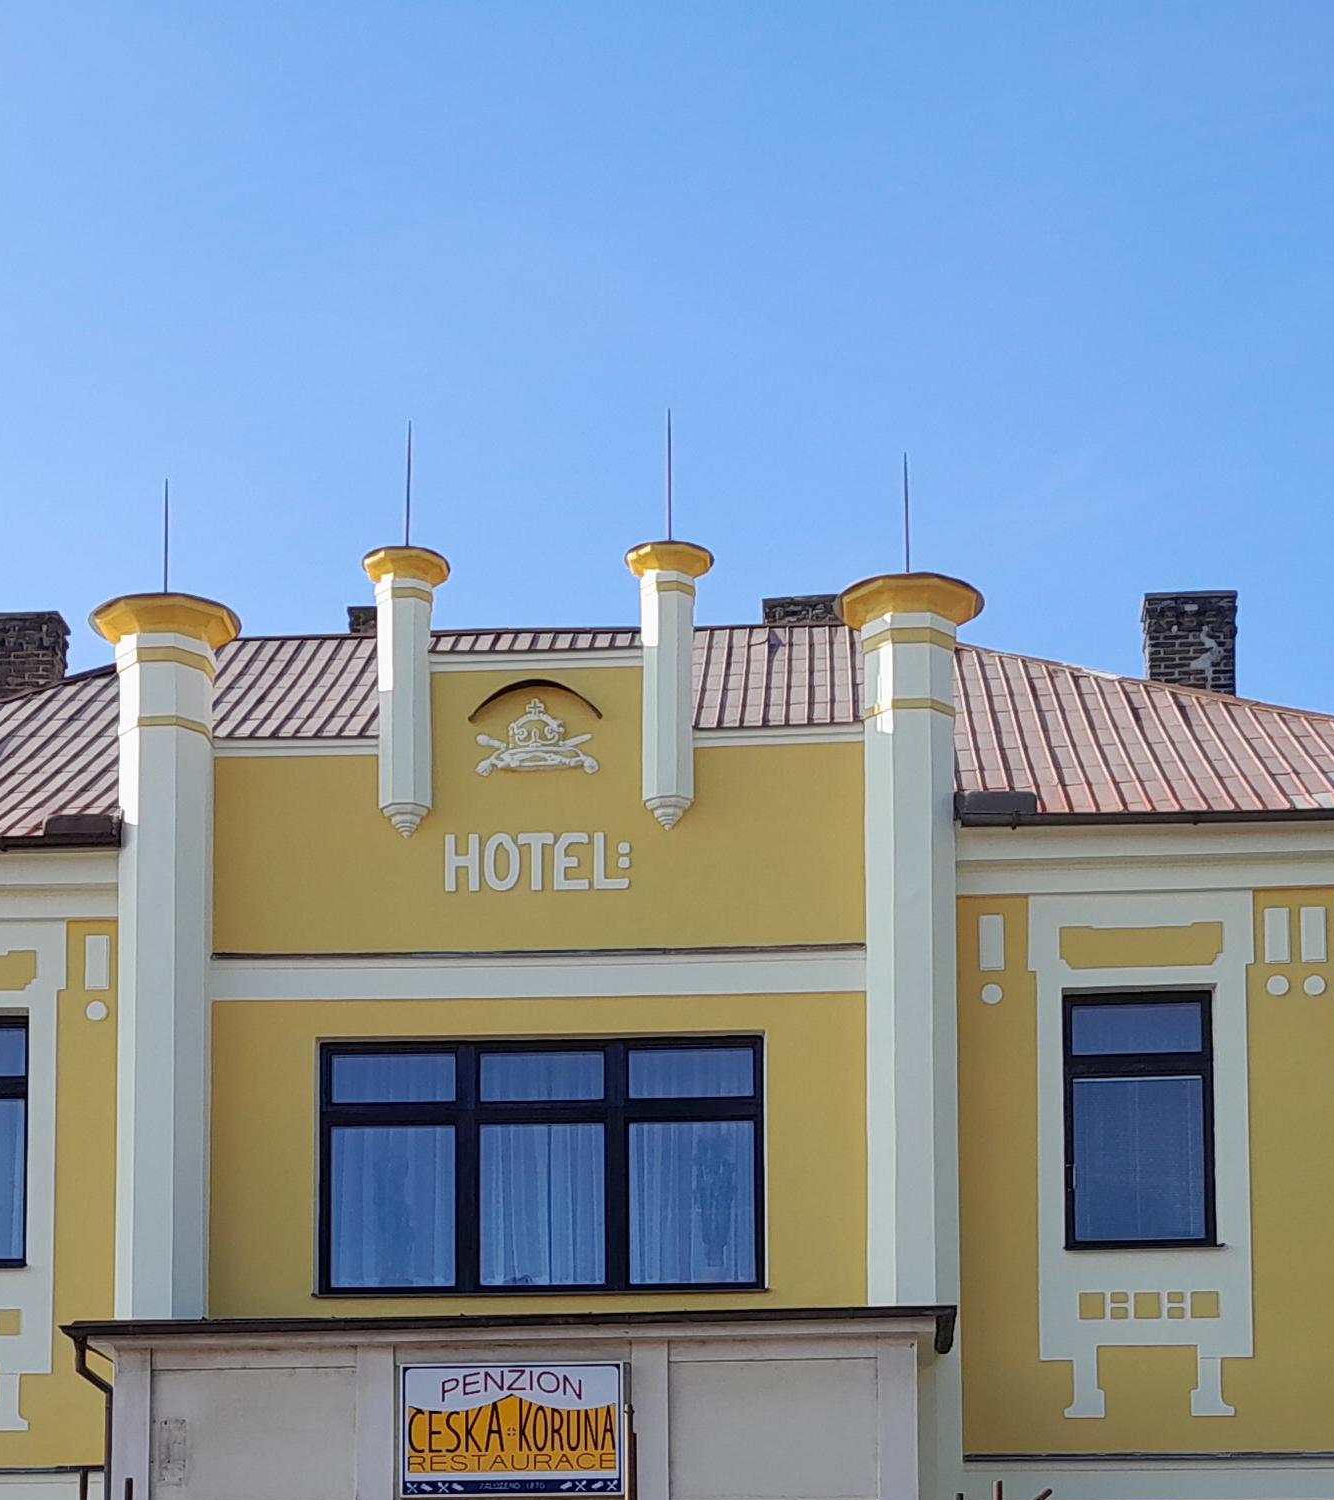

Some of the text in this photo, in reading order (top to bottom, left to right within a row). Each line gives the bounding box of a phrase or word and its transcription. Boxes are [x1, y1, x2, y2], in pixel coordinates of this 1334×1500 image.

[441, 1369, 583, 1403] PENZION
[519, 1397, 616, 1452] KORUNA
[407, 1452, 617, 1472] RESTAURACE
